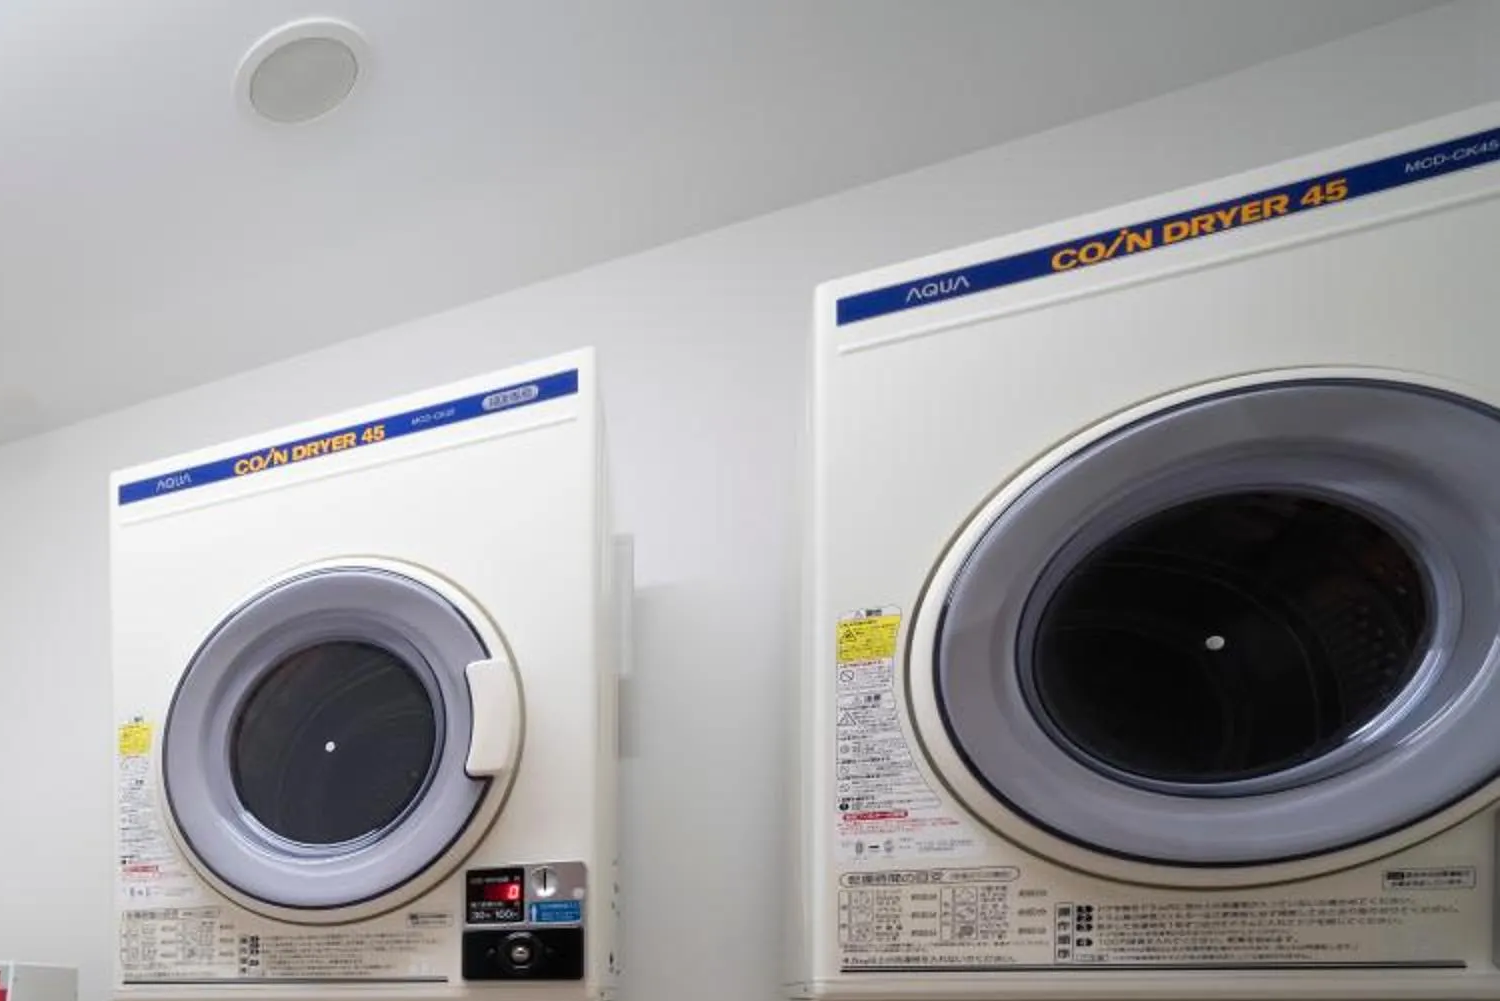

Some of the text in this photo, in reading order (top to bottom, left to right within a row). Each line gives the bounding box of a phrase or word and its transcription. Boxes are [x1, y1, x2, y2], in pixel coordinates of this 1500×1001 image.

[1051, 177, 1350, 272] COIN DRYER 45
[905, 274, 970, 303] AQUA
[233, 424, 386, 476] COIN DRYER 45
[155, 472, 193, 493] AQUA
[508, 884, 520, 900] 0
